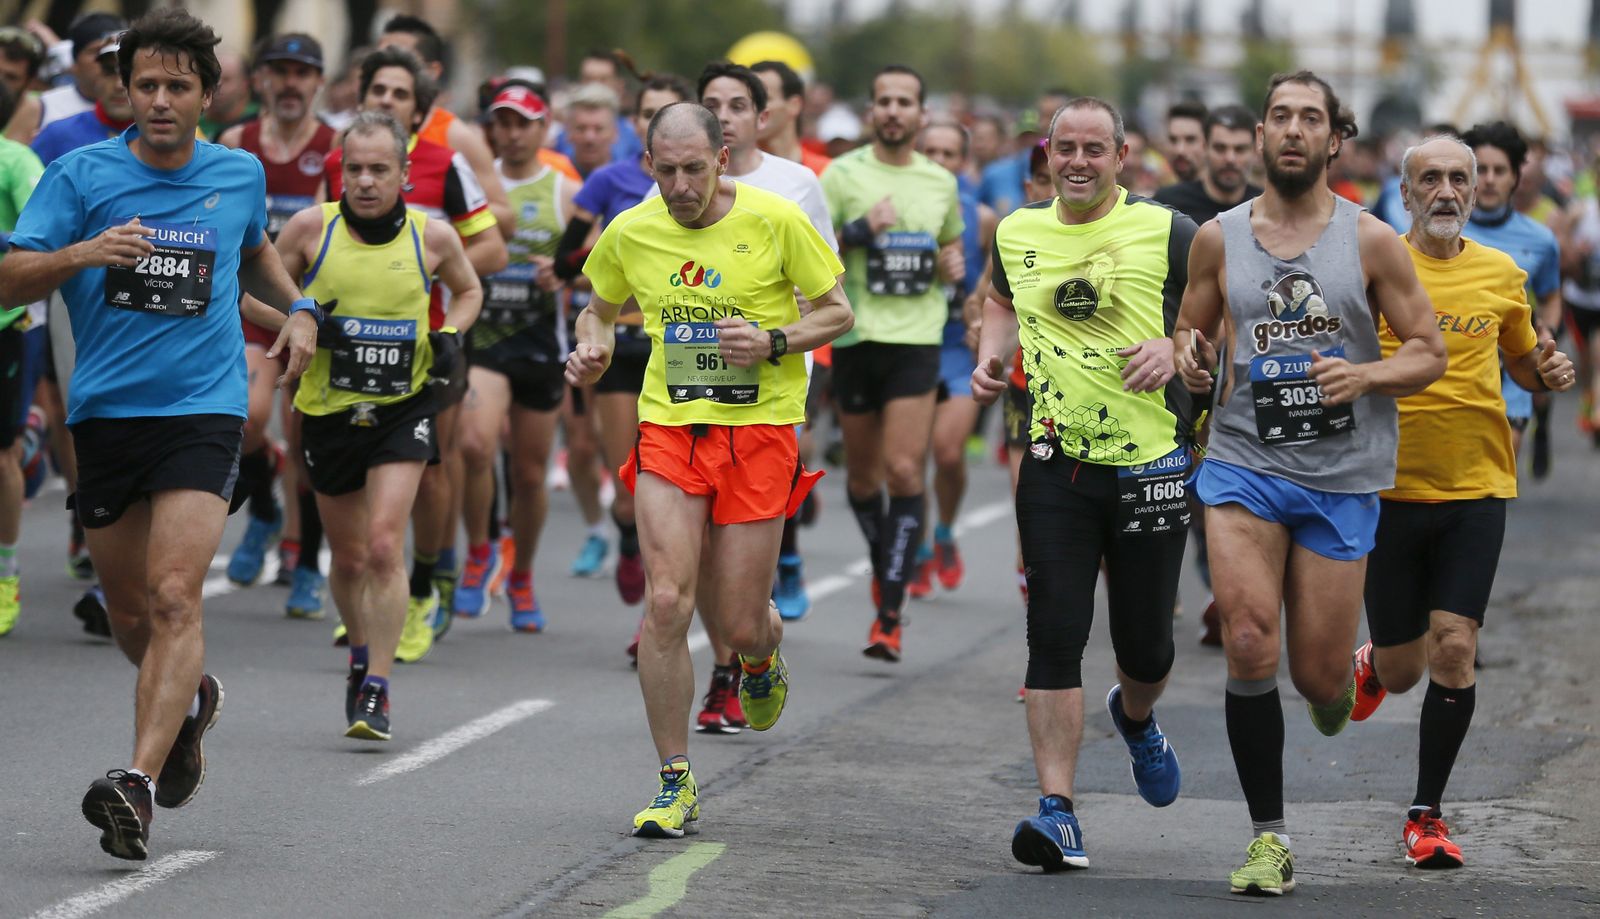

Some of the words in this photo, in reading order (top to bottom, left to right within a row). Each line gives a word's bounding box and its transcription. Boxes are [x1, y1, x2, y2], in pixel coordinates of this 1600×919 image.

[135, 256, 190, 278] 2884
[884, 255, 920, 272] 3211
[144, 279, 174, 289] VÍCTOR
[658, 294, 736, 306] ATLETISMO
[363, 324, 409, 336] ZURICH
[1437, 315, 1490, 333] ELIX
[1252, 314, 1342, 354] gordos
[355, 346, 399, 365] 1610
[696, 353, 728, 370] 961
[1289, 408, 1323, 418] IVANIARD
[1144, 480, 1184, 502] 1608
[1134, 505, 1154, 514] DAVID
